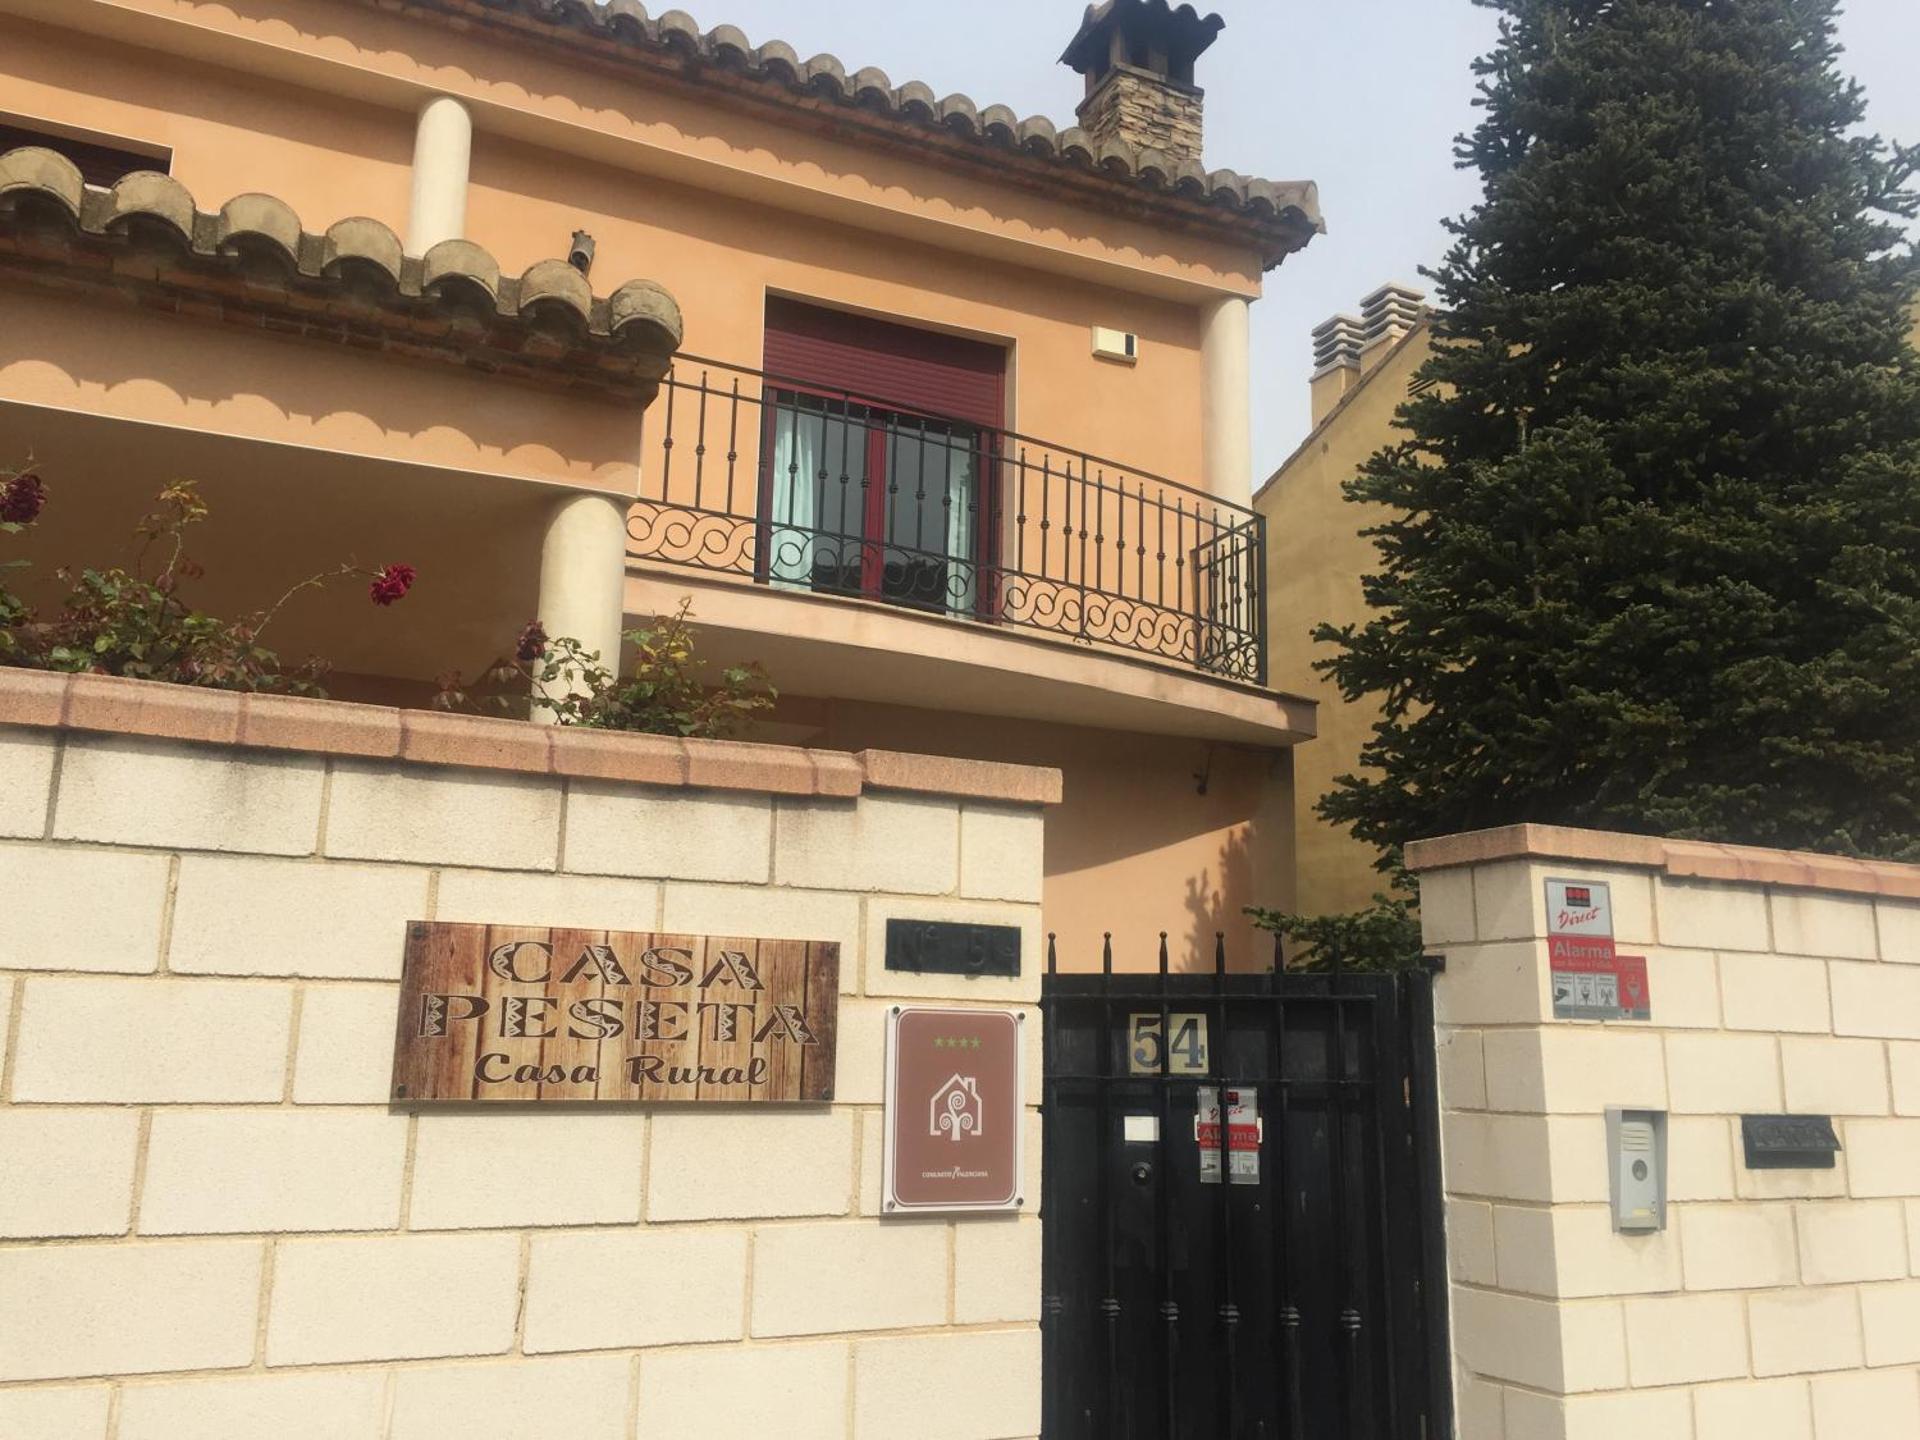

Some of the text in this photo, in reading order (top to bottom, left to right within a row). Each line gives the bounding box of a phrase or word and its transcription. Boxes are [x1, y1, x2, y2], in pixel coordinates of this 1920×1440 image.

[1558, 907, 1601, 929] Direct
[488, 941, 766, 991] CASA
[1554, 941, 1612, 959] Alarma
[418, 992, 820, 1045] PESETA
[1134, 1017, 1205, 1069] 54
[473, 1052, 768, 1085] Casa Rural
